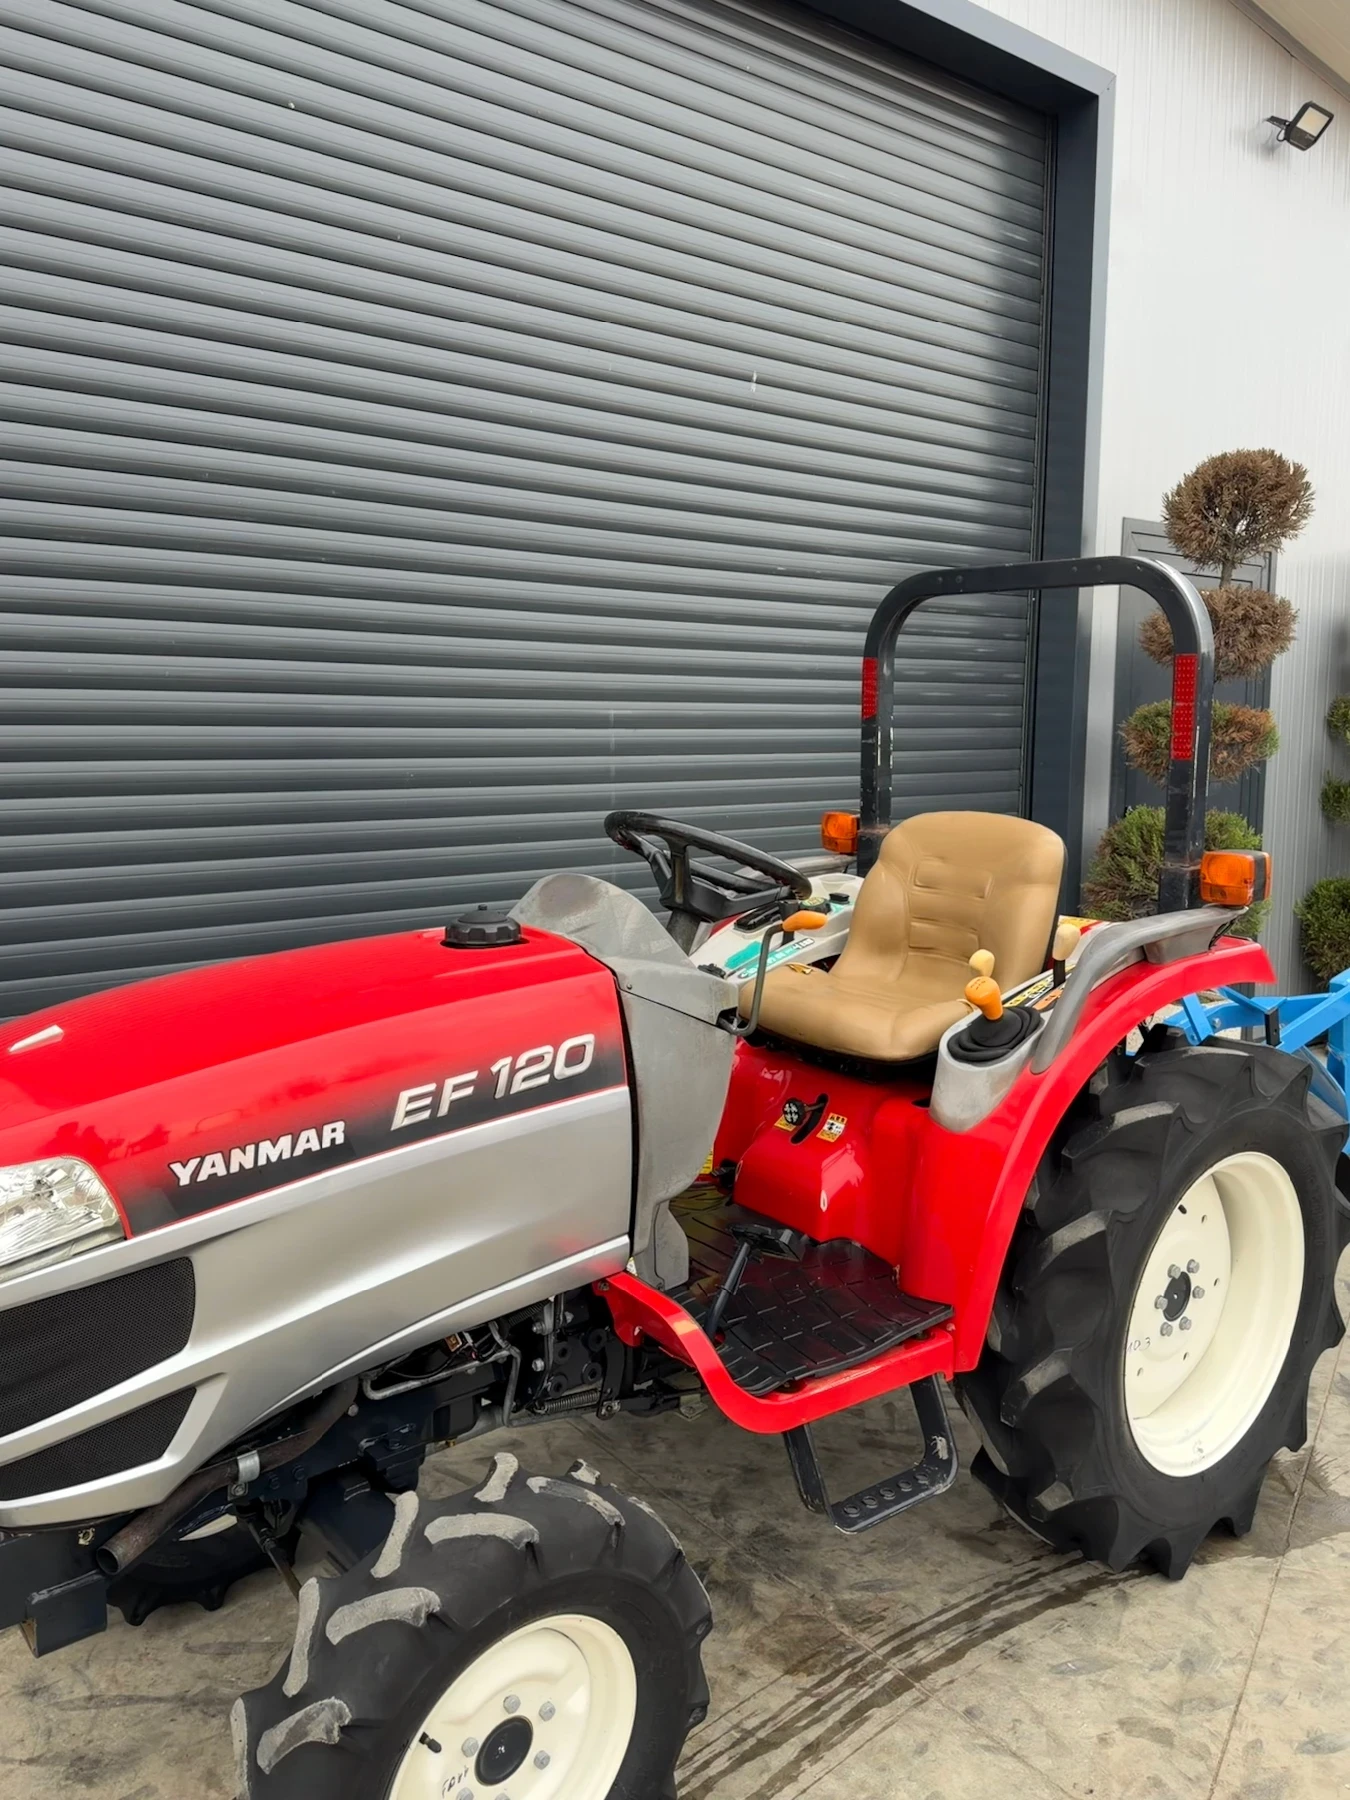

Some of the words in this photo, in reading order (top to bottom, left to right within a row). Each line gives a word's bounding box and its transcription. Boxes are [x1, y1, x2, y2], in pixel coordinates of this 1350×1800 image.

[390, 1070, 479, 1131] EF
[490, 1033, 595, 1099] 120
[169, 1120, 346, 1187] YANMAR
